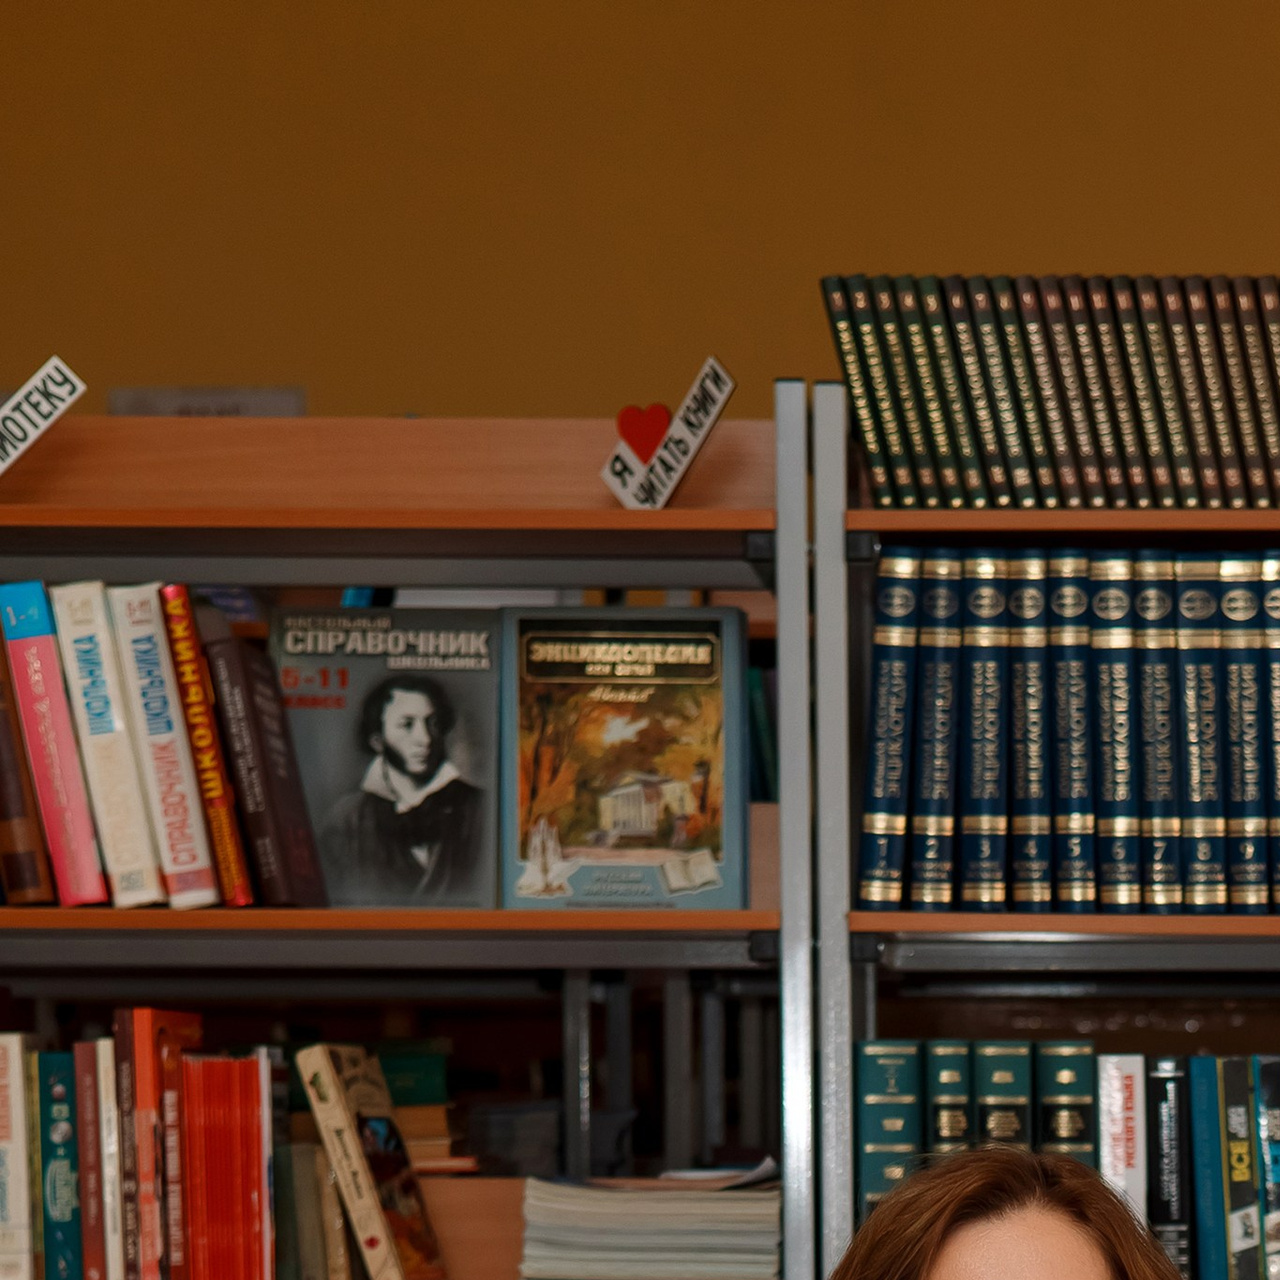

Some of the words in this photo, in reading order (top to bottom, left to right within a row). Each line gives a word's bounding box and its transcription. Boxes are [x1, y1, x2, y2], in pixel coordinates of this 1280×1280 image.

[680, 363, 729, 437] КНИГИ
[610, 454, 635, 488] Я
[284, 630, 489, 655] СПРАВОЧНИК
[72, 633, 114, 736] ШКОЛЬНИКА
[131, 634, 174, 736] ШКОЛЬНИКА
[166, 596, 225, 800] ШКОЛЬНИКА
[149, 739, 197, 866] СПРАВОЧНИК
[877, 837, 888, 856] 1
[925, 838, 939, 858] 2
[980, 839, 990, 858] 3
[1068, 837, 1081, 857] 5
[1112, 841, 1125, 860] 6
[1153, 841, 1166, 860] 7
[1196, 841, 1211, 860] 8
[1240, 841, 1254, 860] 9
